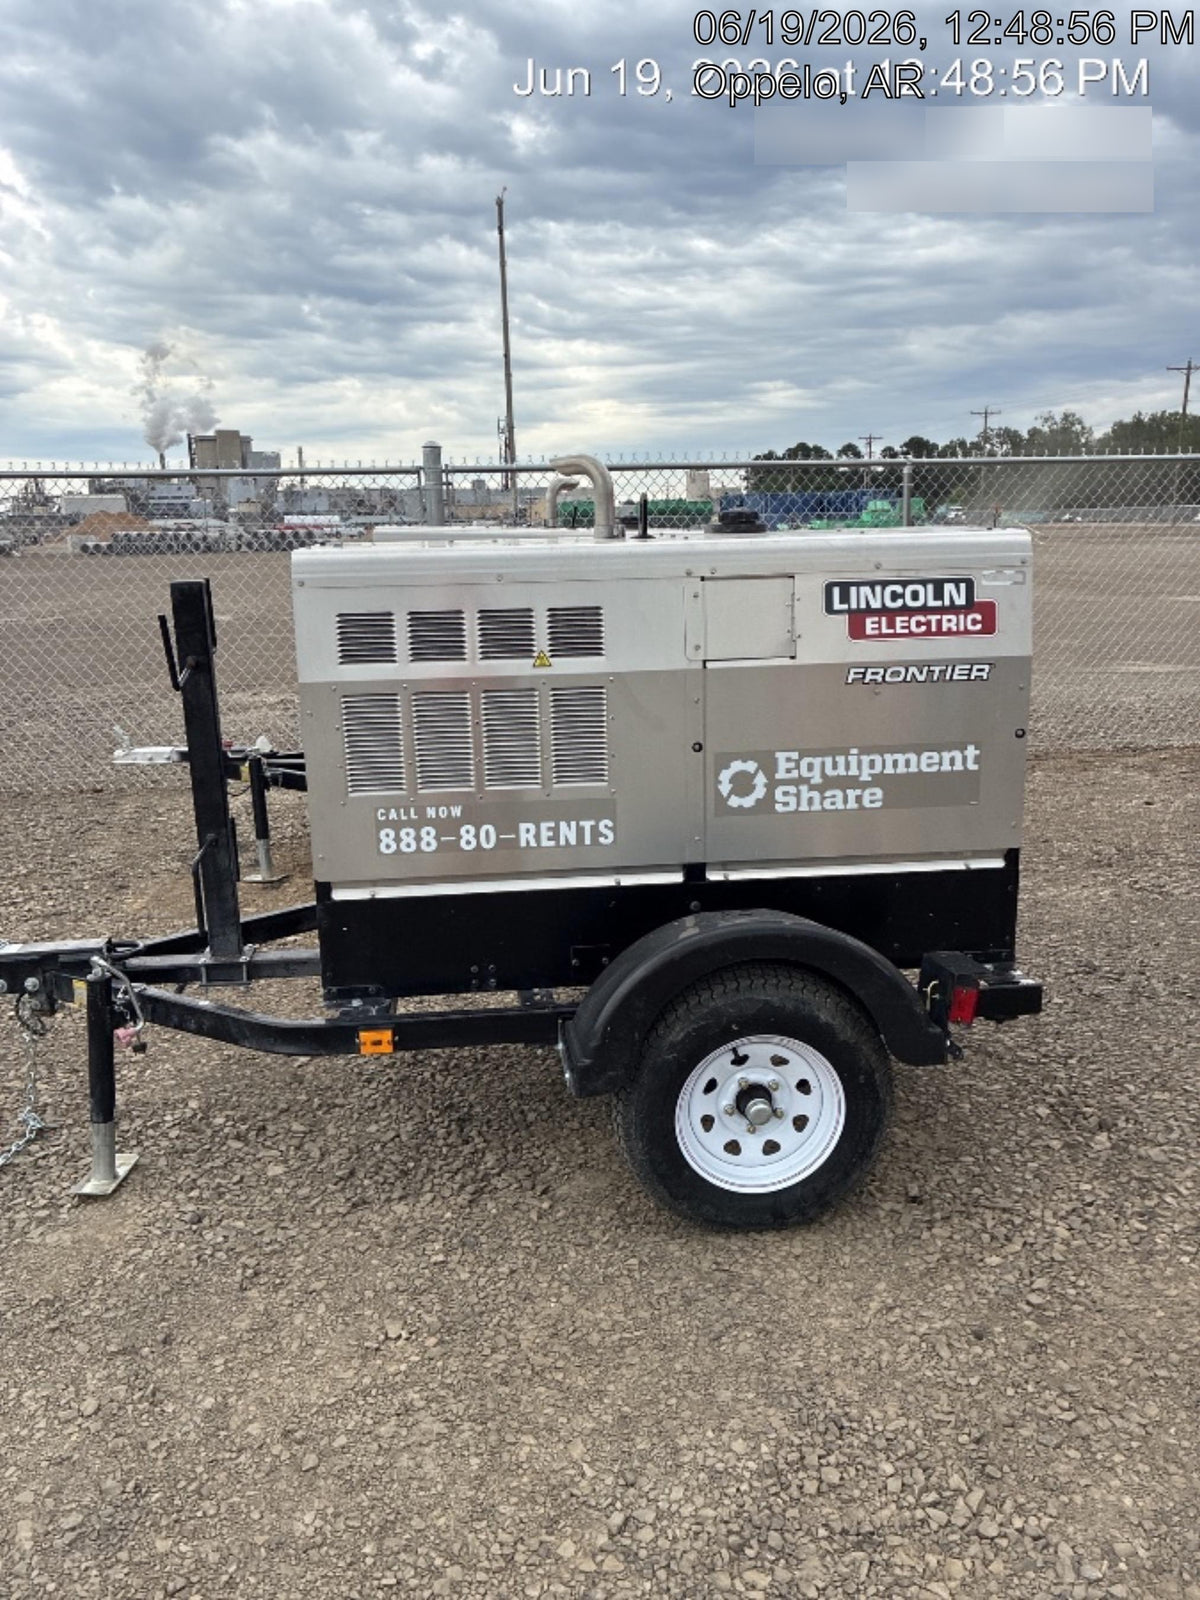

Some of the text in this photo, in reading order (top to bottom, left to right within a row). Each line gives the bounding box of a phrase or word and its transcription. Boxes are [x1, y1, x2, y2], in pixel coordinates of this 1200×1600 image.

[831, 582, 968, 611] LINCOLN
[864, 613, 983, 636] ELECTRIC
[846, 663, 993, 685] FRONTIER
[774, 744, 981, 784] Equipment
[376, 804, 463, 821] CALL NOW
[774, 784, 884, 813] Share
[378, 818, 615, 855] 888-80-RENTS
